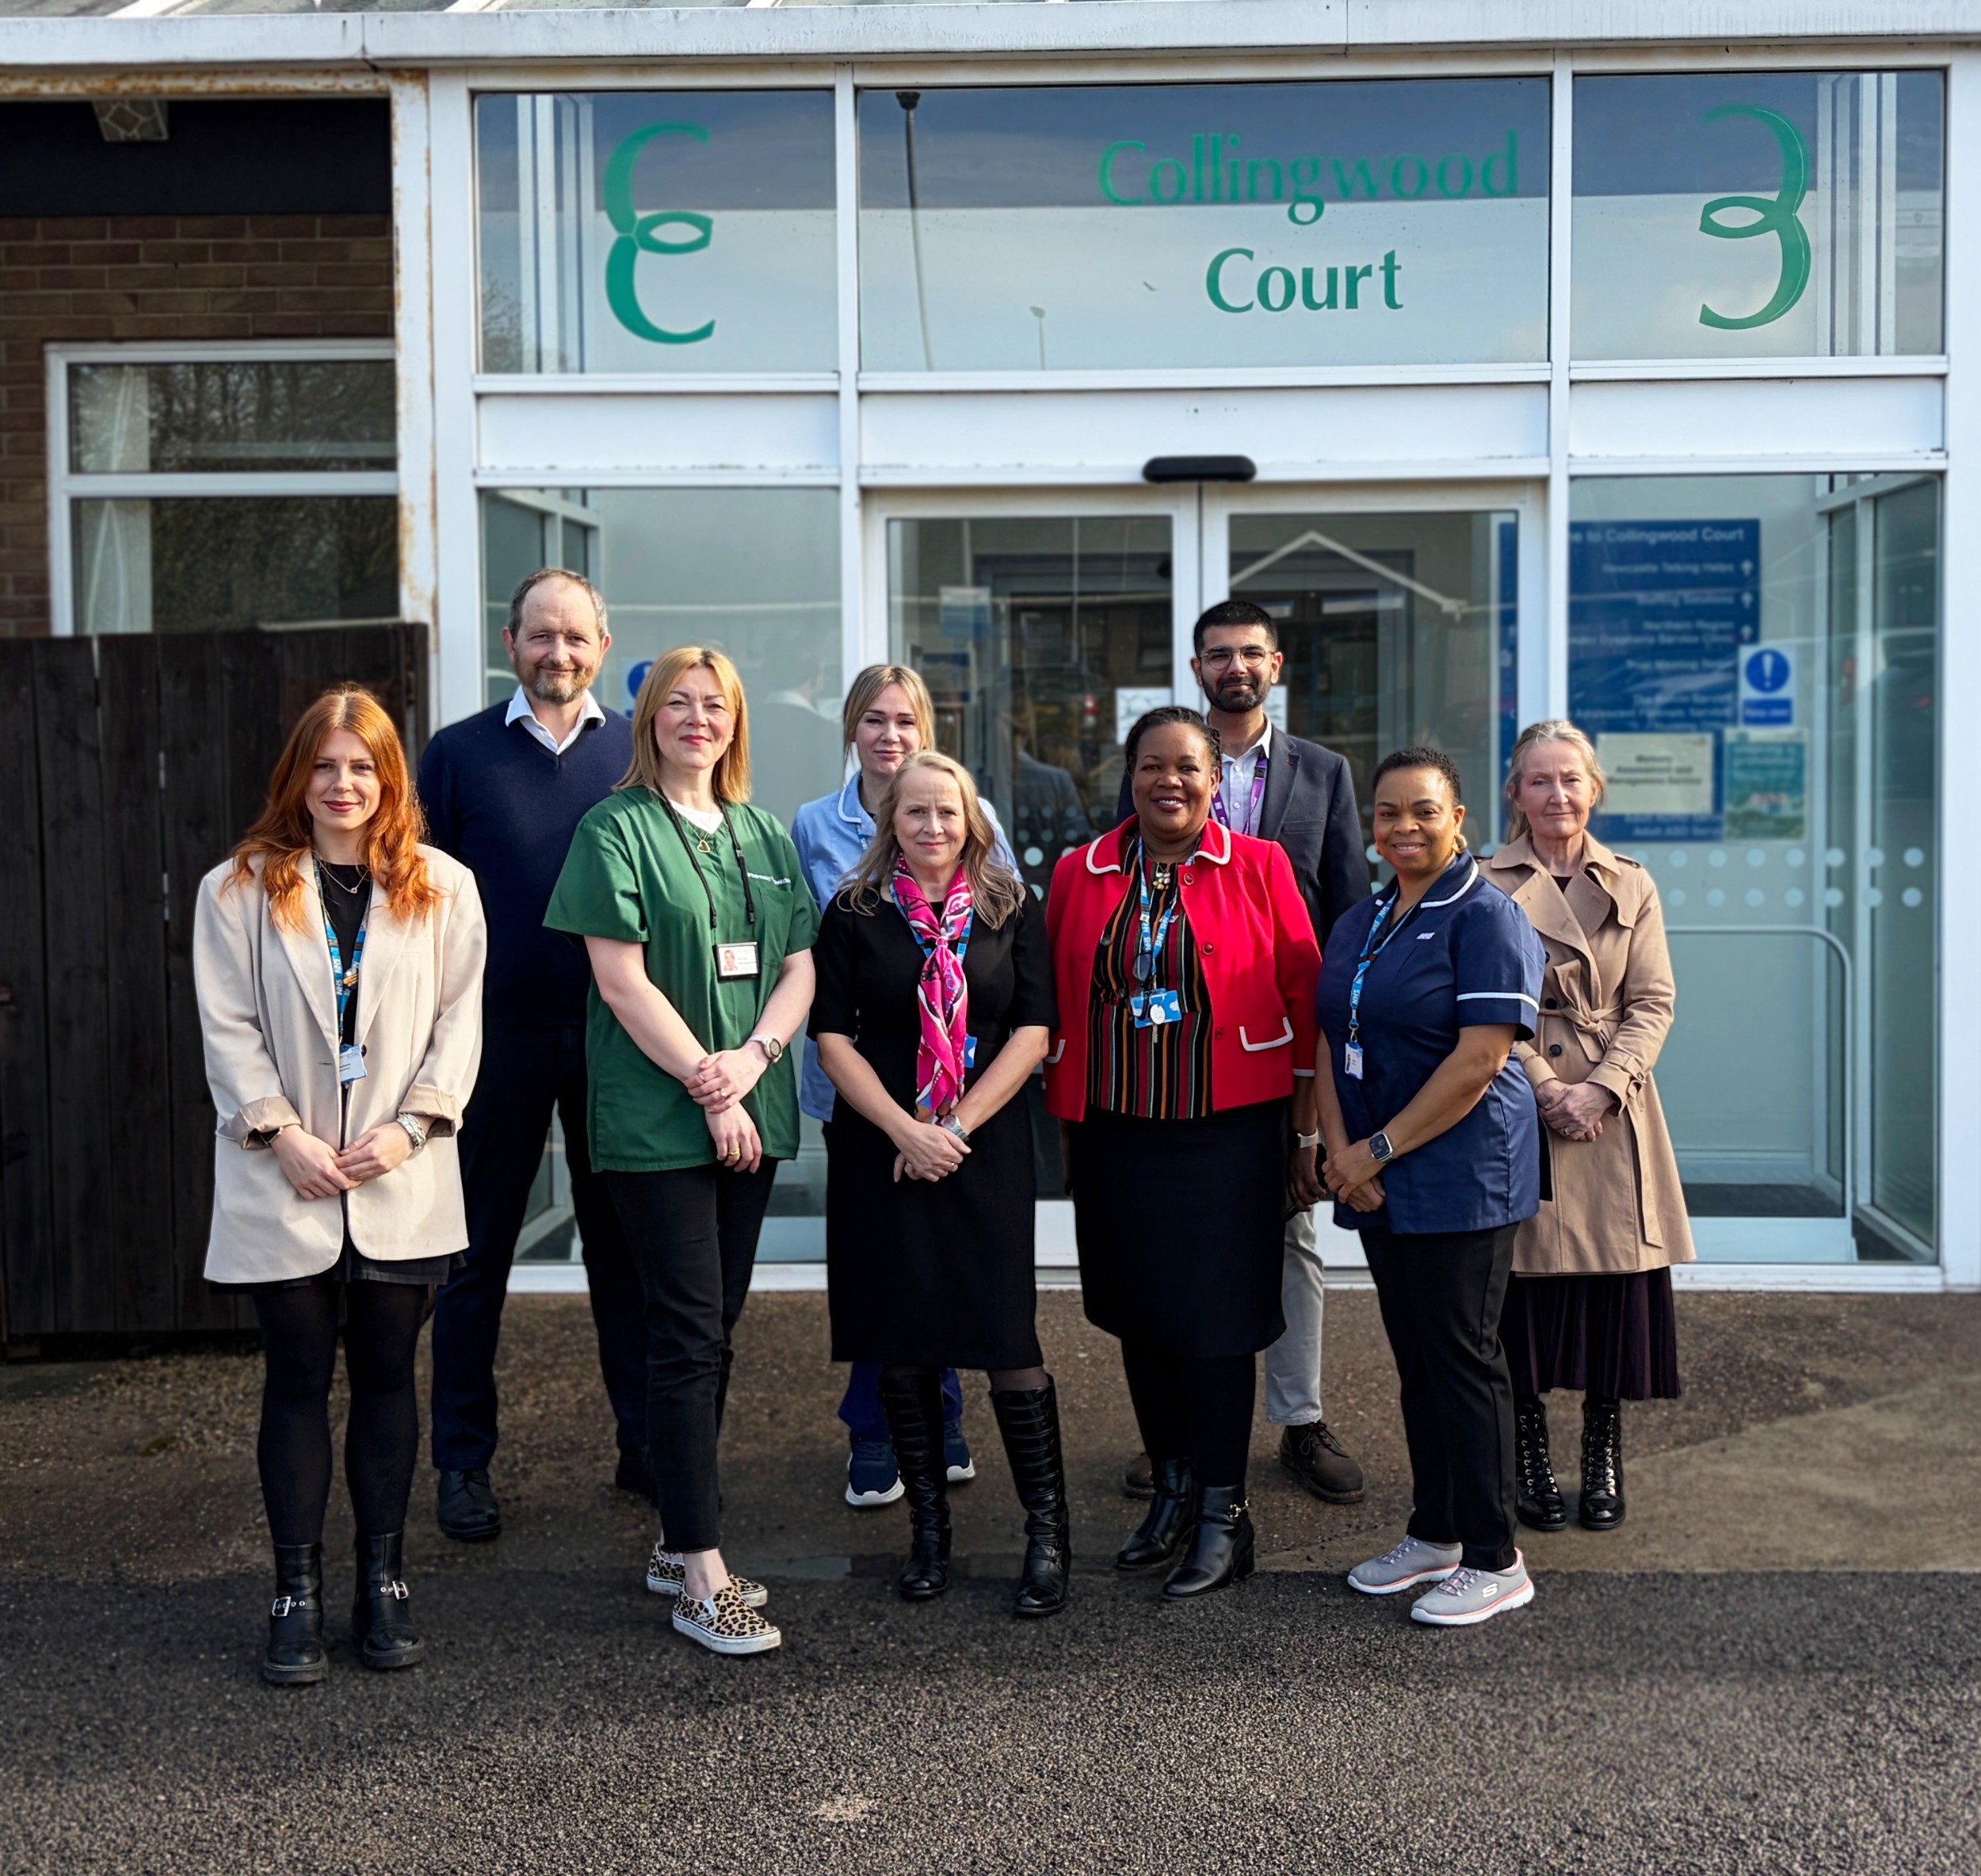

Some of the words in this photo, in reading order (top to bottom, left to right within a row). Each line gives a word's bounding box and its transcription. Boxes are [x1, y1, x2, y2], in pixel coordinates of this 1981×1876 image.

[1098, 128, 1518, 225] Collingwood
[1206, 247, 1403, 314] Court
[1605, 528, 1697, 546] Collingwood
[1701, 526, 1744, 542] Court
